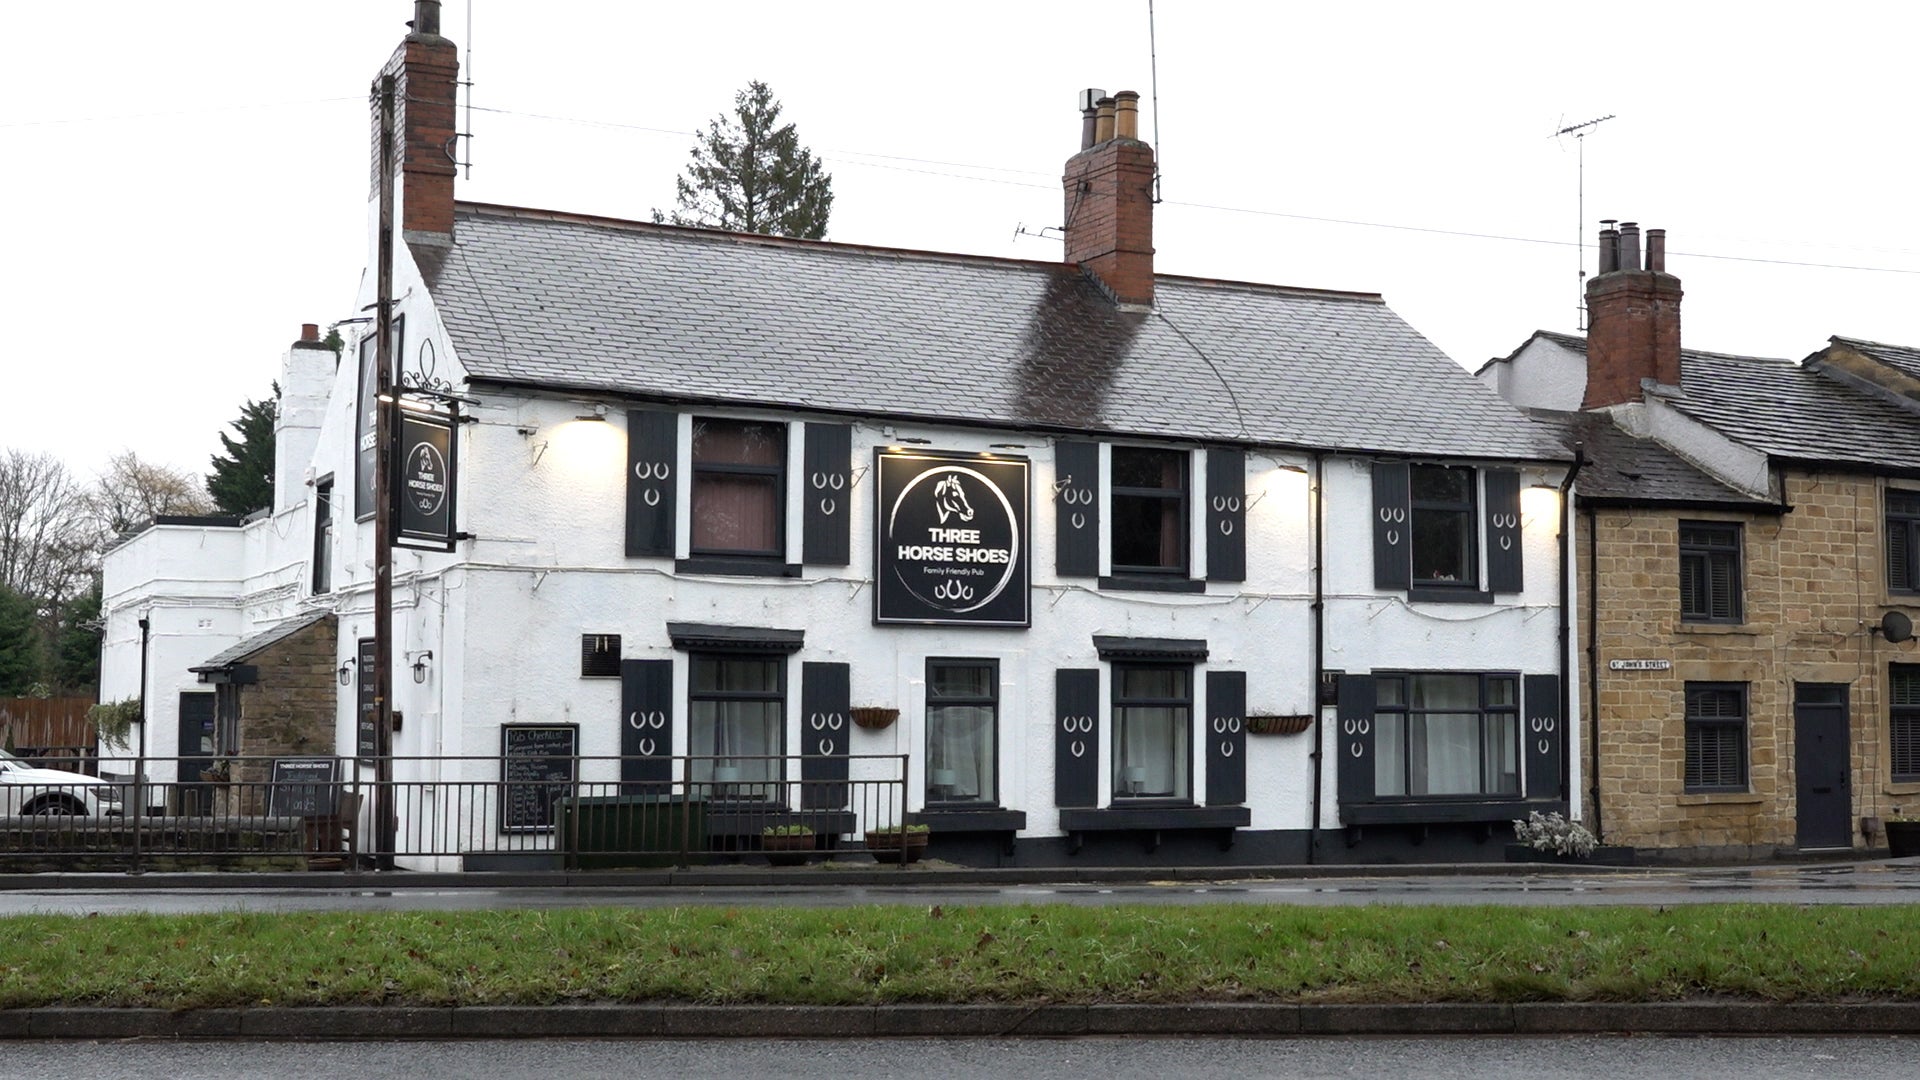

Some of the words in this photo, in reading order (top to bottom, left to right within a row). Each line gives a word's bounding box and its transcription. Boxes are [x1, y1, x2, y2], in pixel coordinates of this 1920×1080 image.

[418, 472, 434, 481] THREE
[409, 480, 425, 489] HORSE
[426, 483, 442, 491] SHOES
[928, 528, 980, 543] THREE
[898, 545, 953, 561] HORSE
[956, 548, 1009, 563] SHOES
[923, 566, 945, 576] Family
[946, 567, 971, 577] Friendly
[972, 568, 985, 576] Pub
